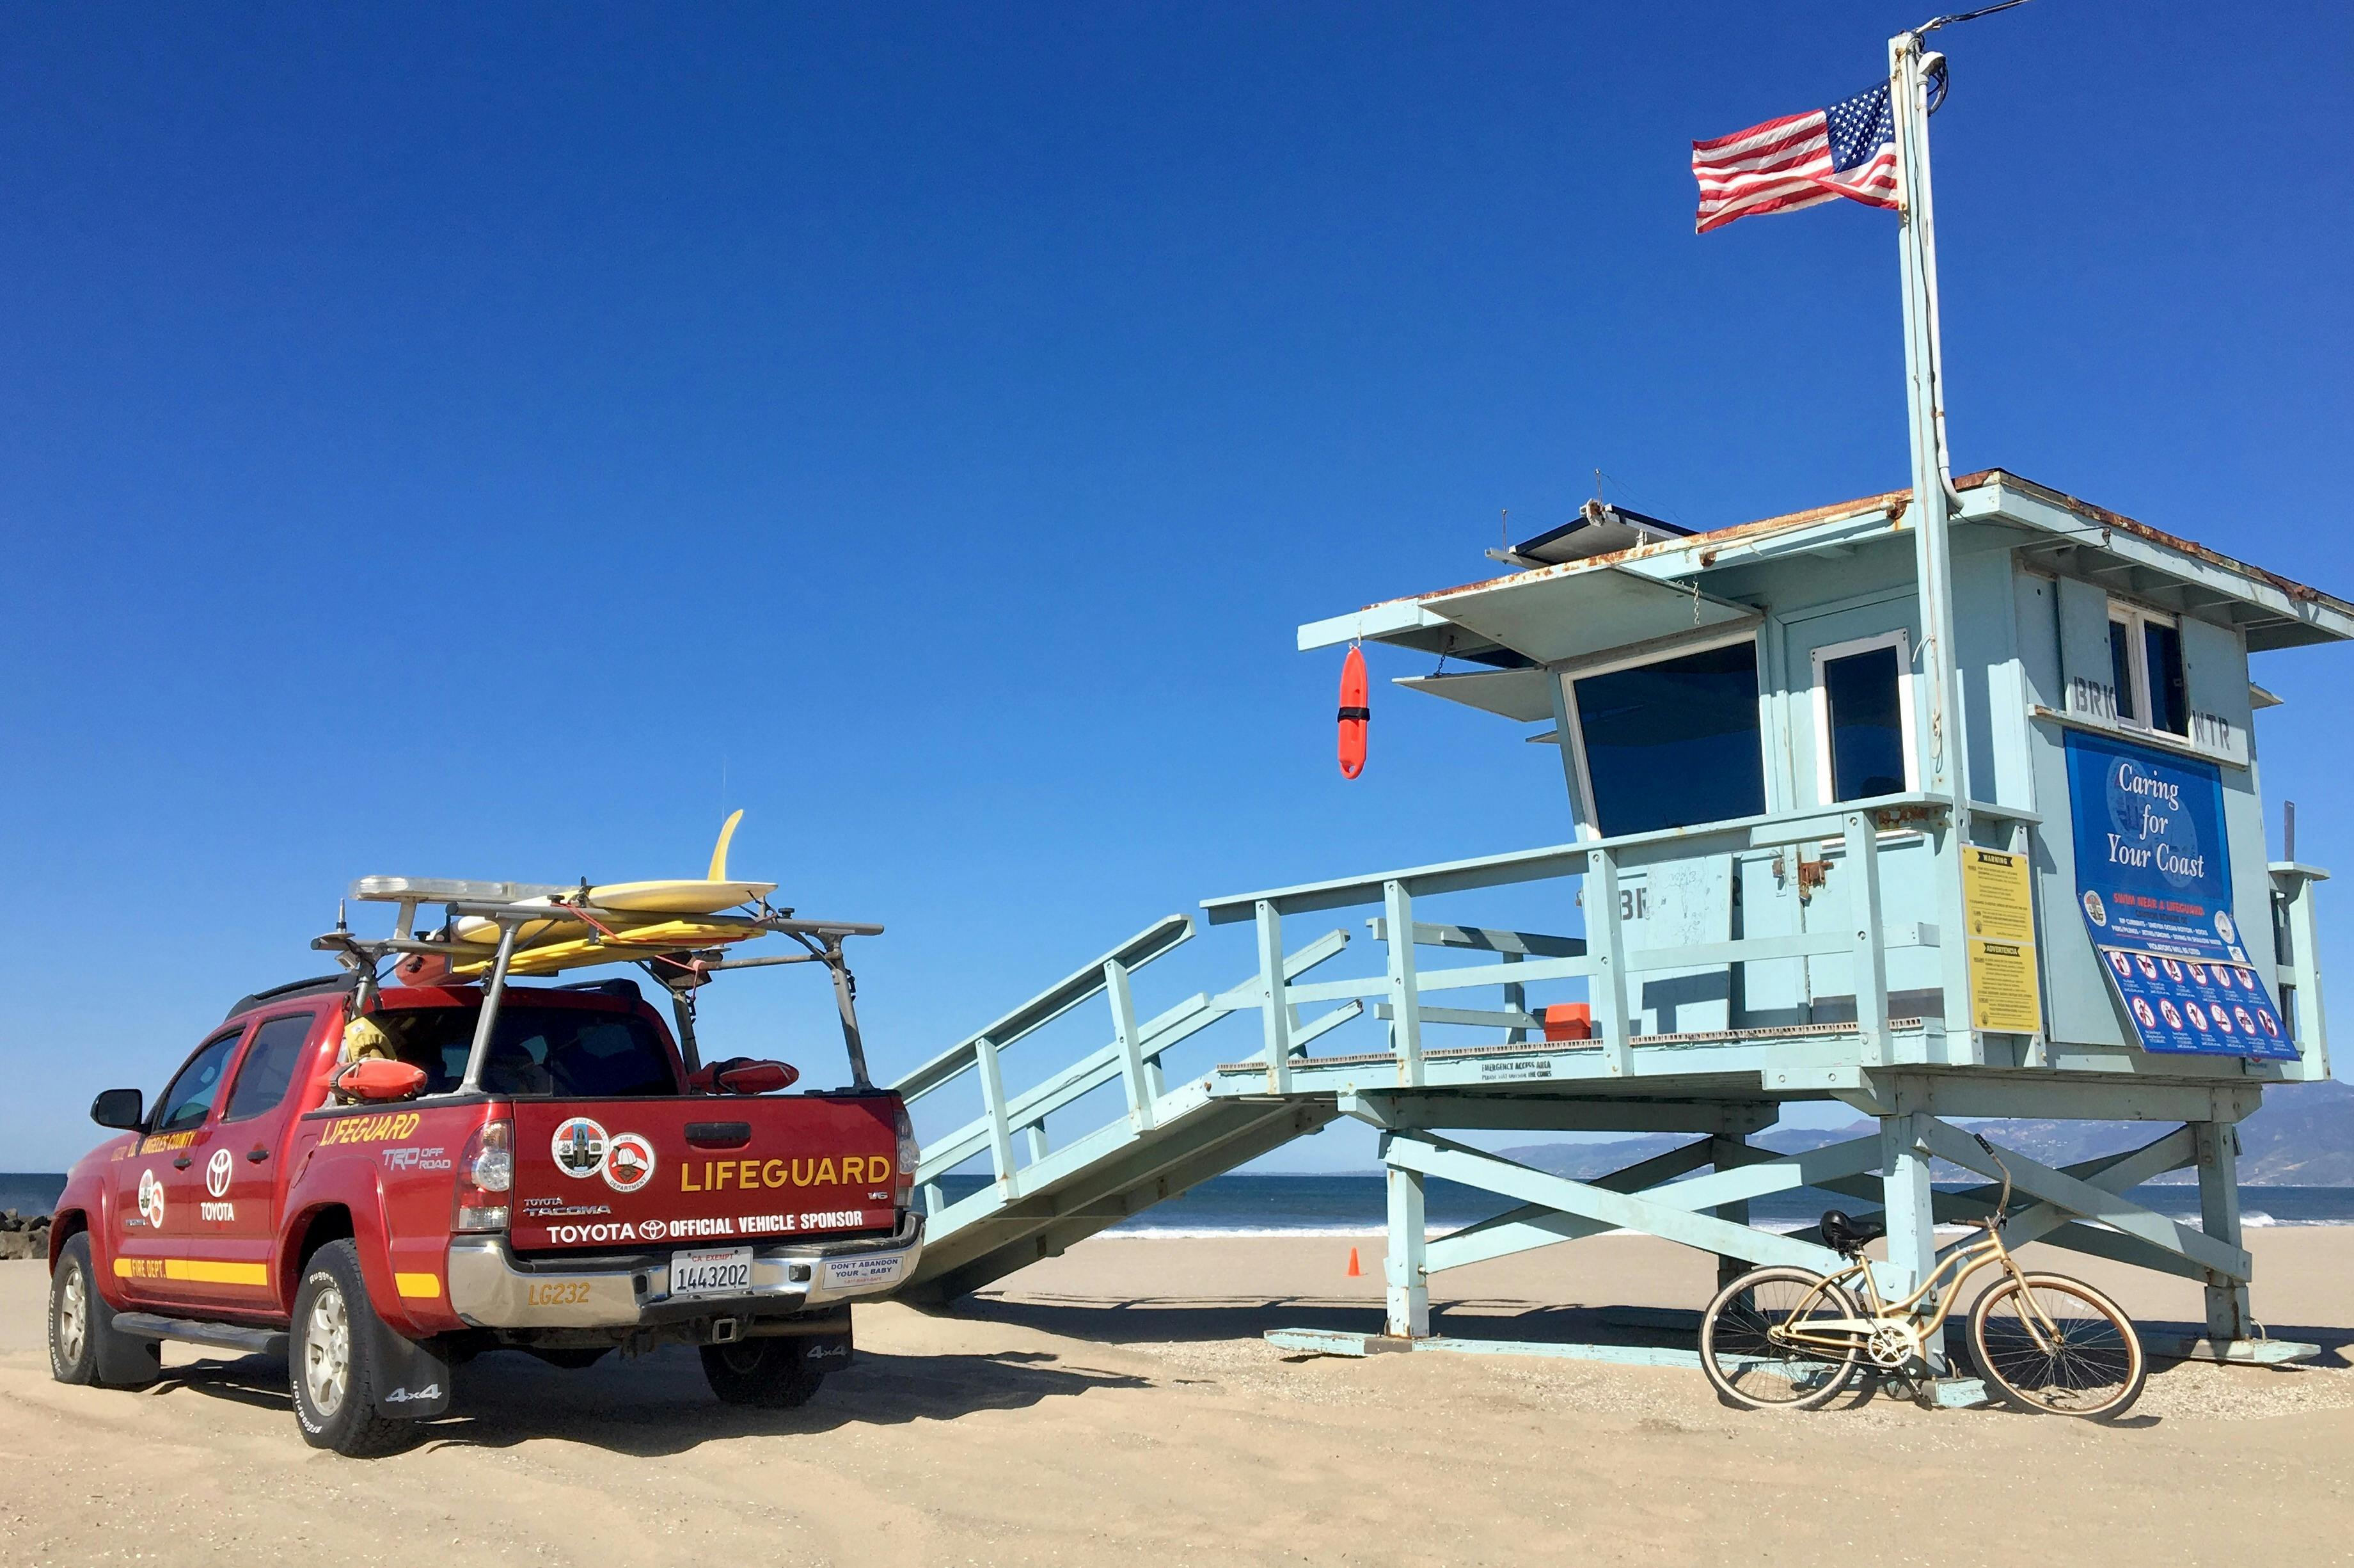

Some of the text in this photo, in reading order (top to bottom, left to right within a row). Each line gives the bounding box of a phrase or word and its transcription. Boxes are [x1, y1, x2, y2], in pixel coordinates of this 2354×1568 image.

[2073, 676, 2231, 751] BRK WTR
[2119, 763, 2179, 811] Caring
[2139, 804, 2168, 840] for
[1983, 854, 2008, 865] WARNING
[2107, 833, 2204, 878] Your Coast
[2113, 892, 2135, 905] SWIM
[2137, 896, 2158, 909] NEAR
[2160, 899, 2165, 911] A
[1481, 1061, 1551, 1072] EMERGENCY ACCESS AREA
[319, 1113, 420, 1147] LIFEGUARD
[555, 1121, 569, 1137] COUNTY
[588, 1120, 606, 1137] ANGELES
[166, 1130, 198, 1151] COUNTY
[382, 1147, 420, 1171] TRD
[420, 1147, 445, 1157] OFF
[418, 1159, 451, 1169] ROAD
[681, 1156, 890, 1192] LIFEGUARD
[609, 1177, 647, 1191] DEPARTMENT
[523, 1197, 563, 1207] TOYOTA
[867, 1191, 889, 1200] V6
[200, 1201, 235, 1221] TOYOTA
[523, 1205, 612, 1217] TACOMA
[546, 1210, 863, 1244] TOYOTA OFFICIAL VEHICLE SPONSOR
[706, 1253, 733, 1262] EXEMPT
[858, 1258, 898, 1267] ABANDON
[132, 1260, 166, 1278] FIRE DEPT.
[677, 1263, 748, 1290] 1443202
[528, 1282, 591, 1306] LG232
[807, 1345, 846, 1359] 4x4
[385, 1382, 442, 1403] 4x4
[292, 1380, 323, 1434] BFGoodrich
